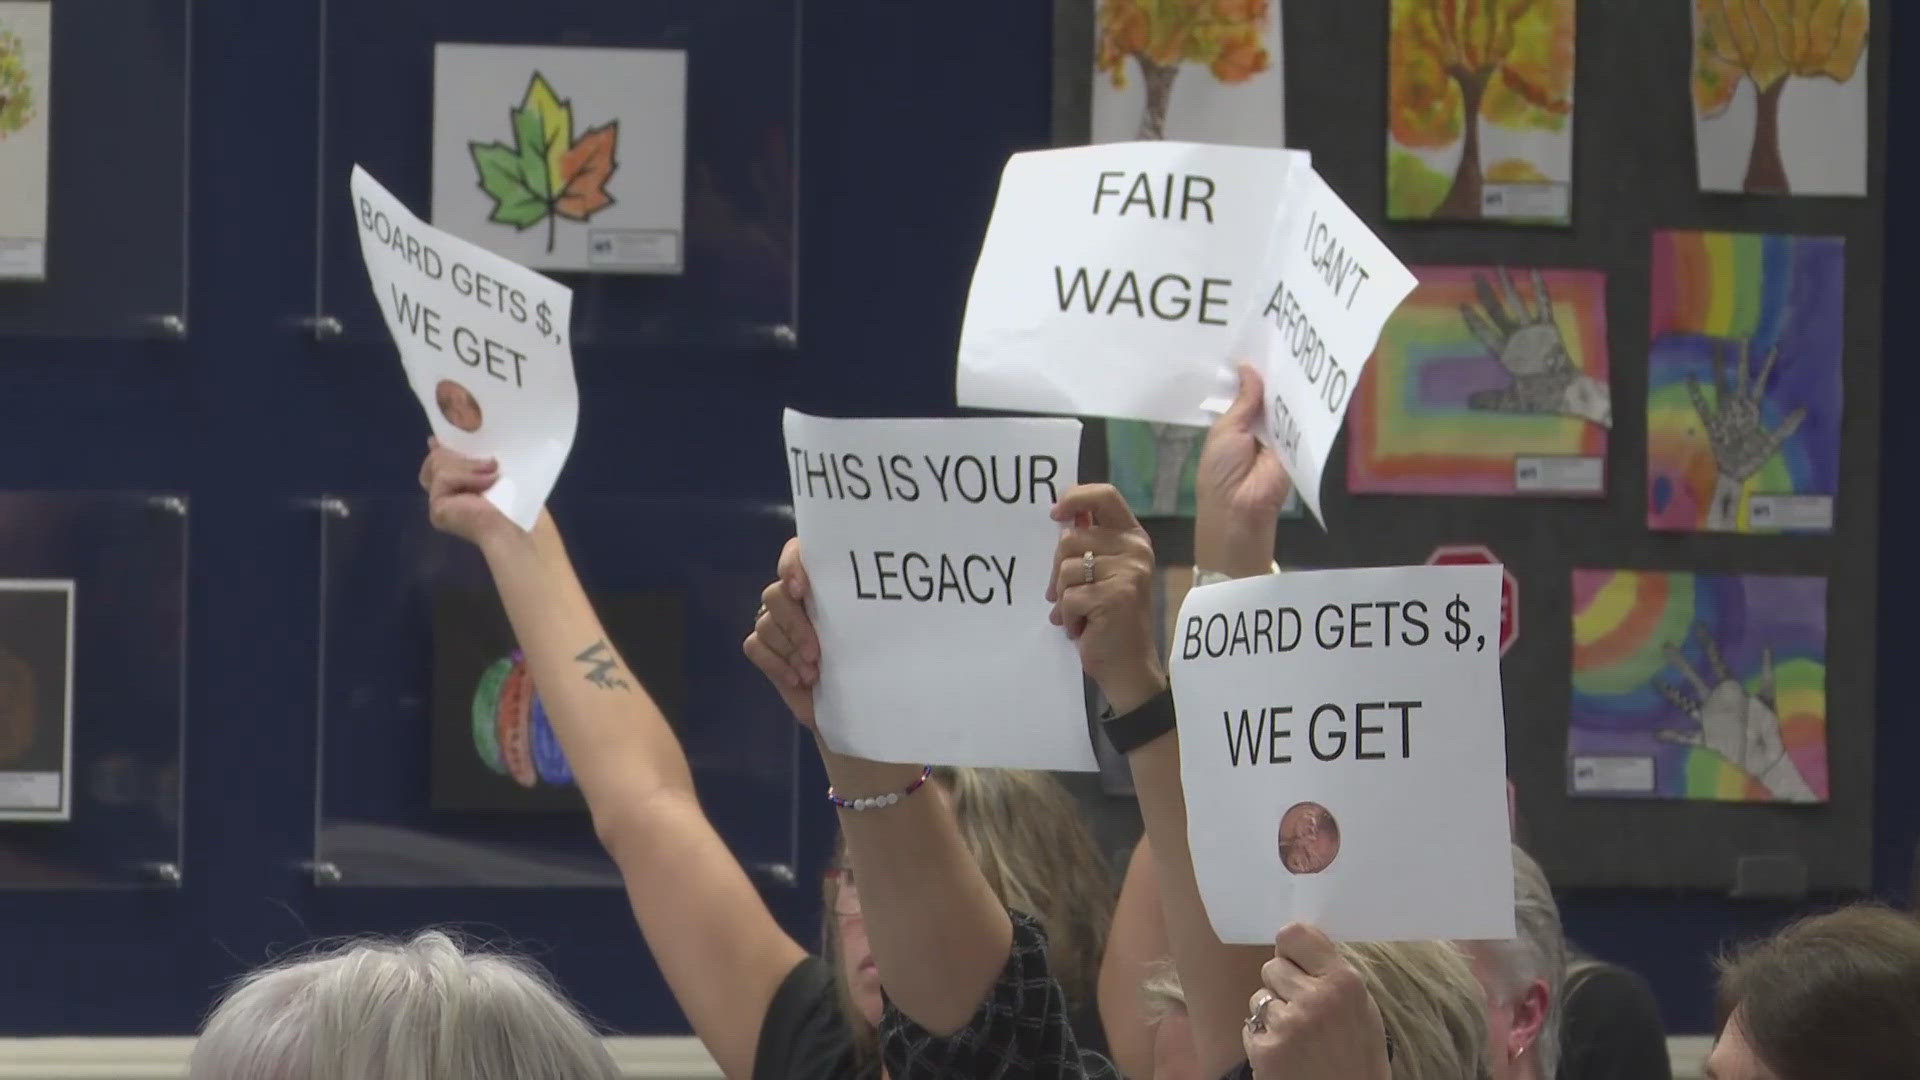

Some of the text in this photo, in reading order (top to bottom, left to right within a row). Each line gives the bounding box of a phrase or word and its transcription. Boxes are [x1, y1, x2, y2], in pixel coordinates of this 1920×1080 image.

[1092, 171, 1217, 223] FAIR
[358, 197, 563, 345] BOARD GETS $,
[1304, 210, 1370, 311] I CAN'T
[1054, 265, 1233, 326] WAGE
[390, 282, 528, 388] WE GET
[1262, 279, 1348, 414] AFFORD TO
[1273, 394, 1302, 468] STAY
[790, 446, 1059, 504] THIS IS YOUR
[849, 550, 1017, 606] LEGACY
[1182, 606, 1302, 660] BOARD
[1314, 598, 1430, 650] GETS
[1443, 593, 1486, 653] $,
[1222, 701, 1423, 767] WE GET
